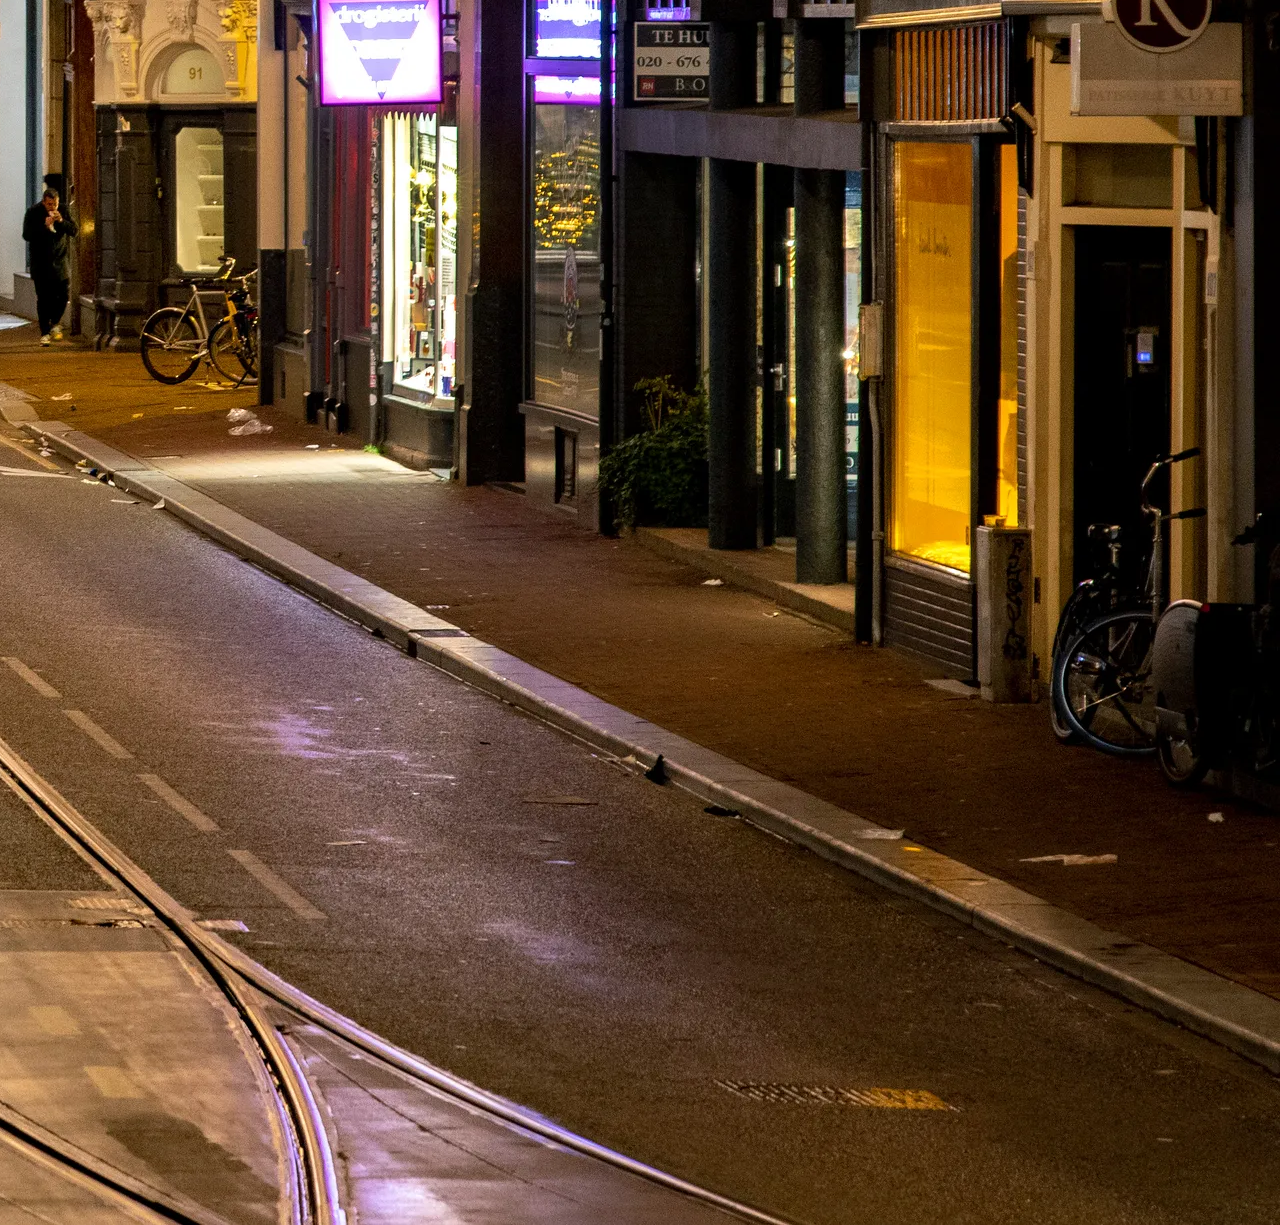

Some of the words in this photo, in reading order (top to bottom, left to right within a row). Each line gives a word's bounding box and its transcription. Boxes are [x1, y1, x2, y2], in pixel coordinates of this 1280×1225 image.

[652, 30, 674, 43] TE
[637, 56, 662, 68] 020
[676, 55, 701, 69] 676
[189, 67, 203, 80] 91
[1172, 86, 1236, 102] KUYT
